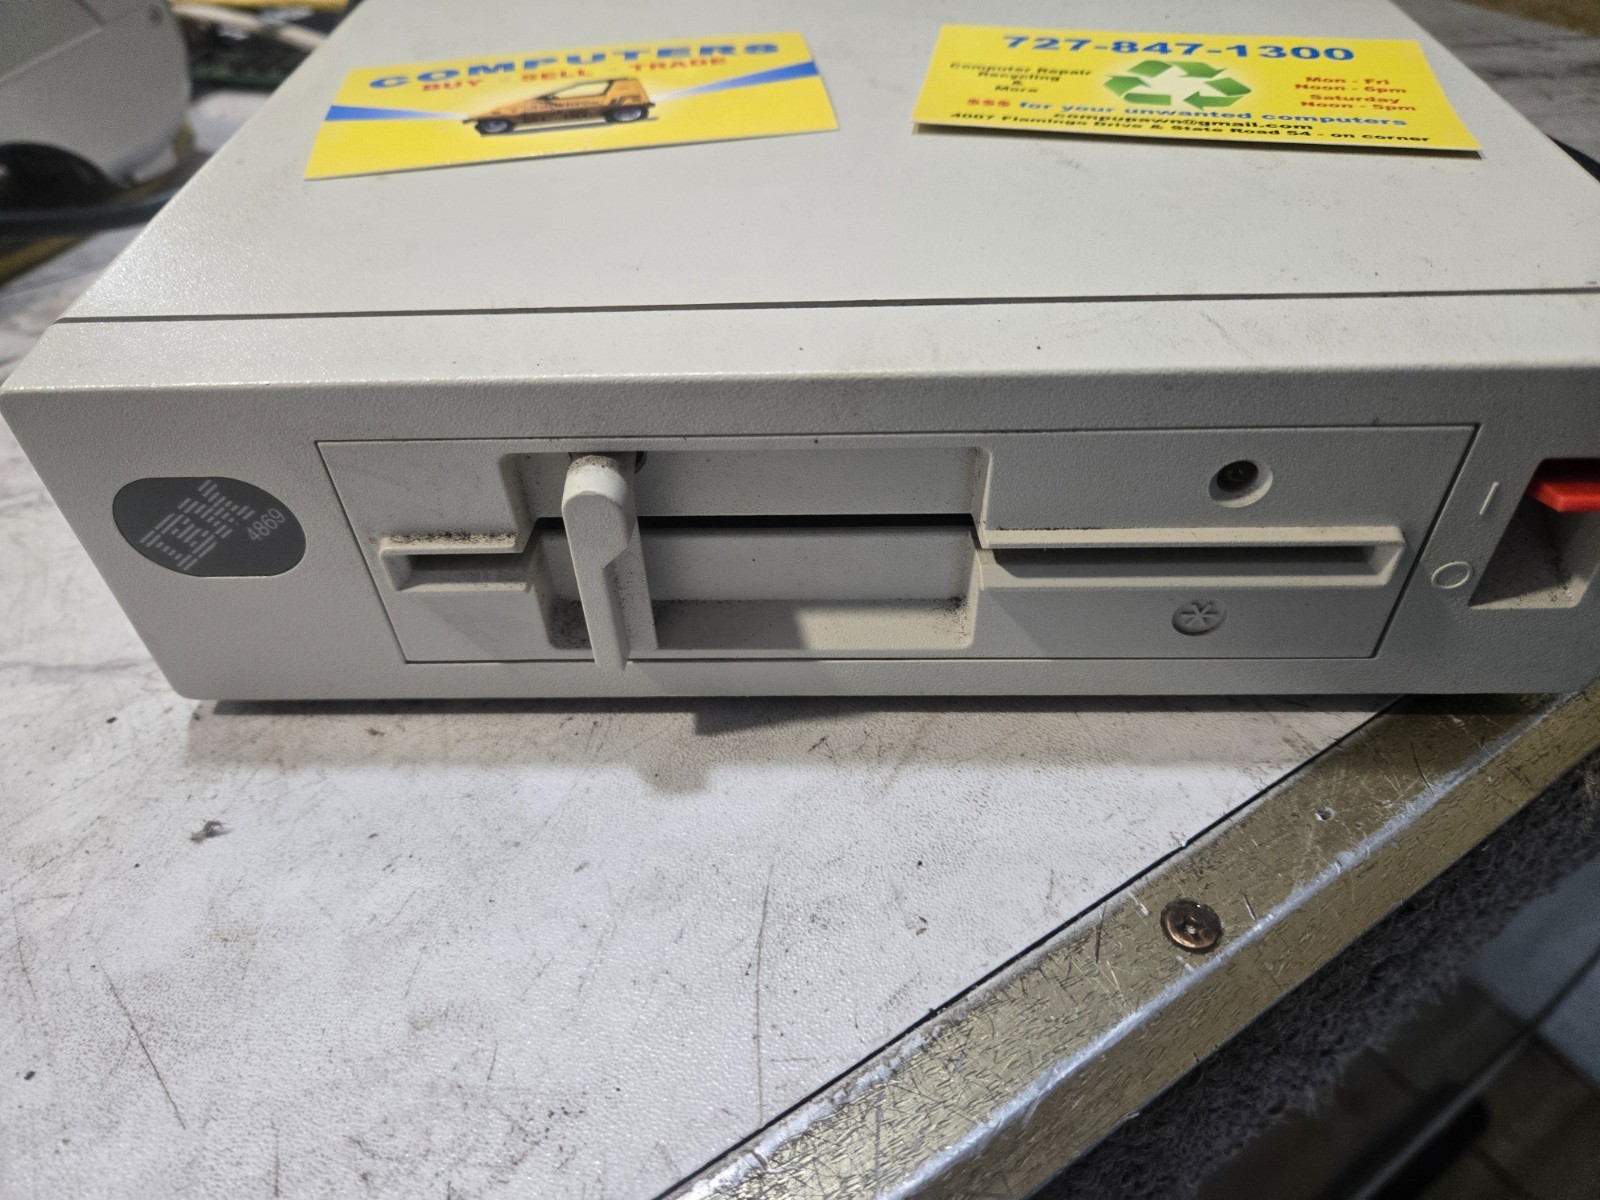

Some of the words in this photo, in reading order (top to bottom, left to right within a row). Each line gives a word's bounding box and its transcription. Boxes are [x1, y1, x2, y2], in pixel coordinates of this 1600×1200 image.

[1003, 34, 1355, 61] 727-847-1300
[369, 43, 778, 89] COMPUTERS
[422, 79, 482, 92] BUY
[521, 69, 592, 82] SELL
[632, 56, 727, 72] TRADE
[950, 62, 1031, 72] Computer
[1037, 66, 1092, 76] Repair
[977, 71, 1061, 82] Recycling
[994, 85, 1038, 93] More
[1305, 76, 1346, 84] Mon
[1300, 101, 1353, 109] Noon
[1309, 94, 1400, 104] Saturday
[1019, 101, 1051, 110] for
[1125, 108, 1252, 119] unwanted
[1262, 113, 1407, 126] computers
[1054, 112, 1313, 130] compupawn@gmail.com
[1002, 115, 1088, 126] Flamingo
[1362, 134, 1430, 142] corner
[139, 478, 256, 571] IBM
[245, 507, 286, 541] 4869
